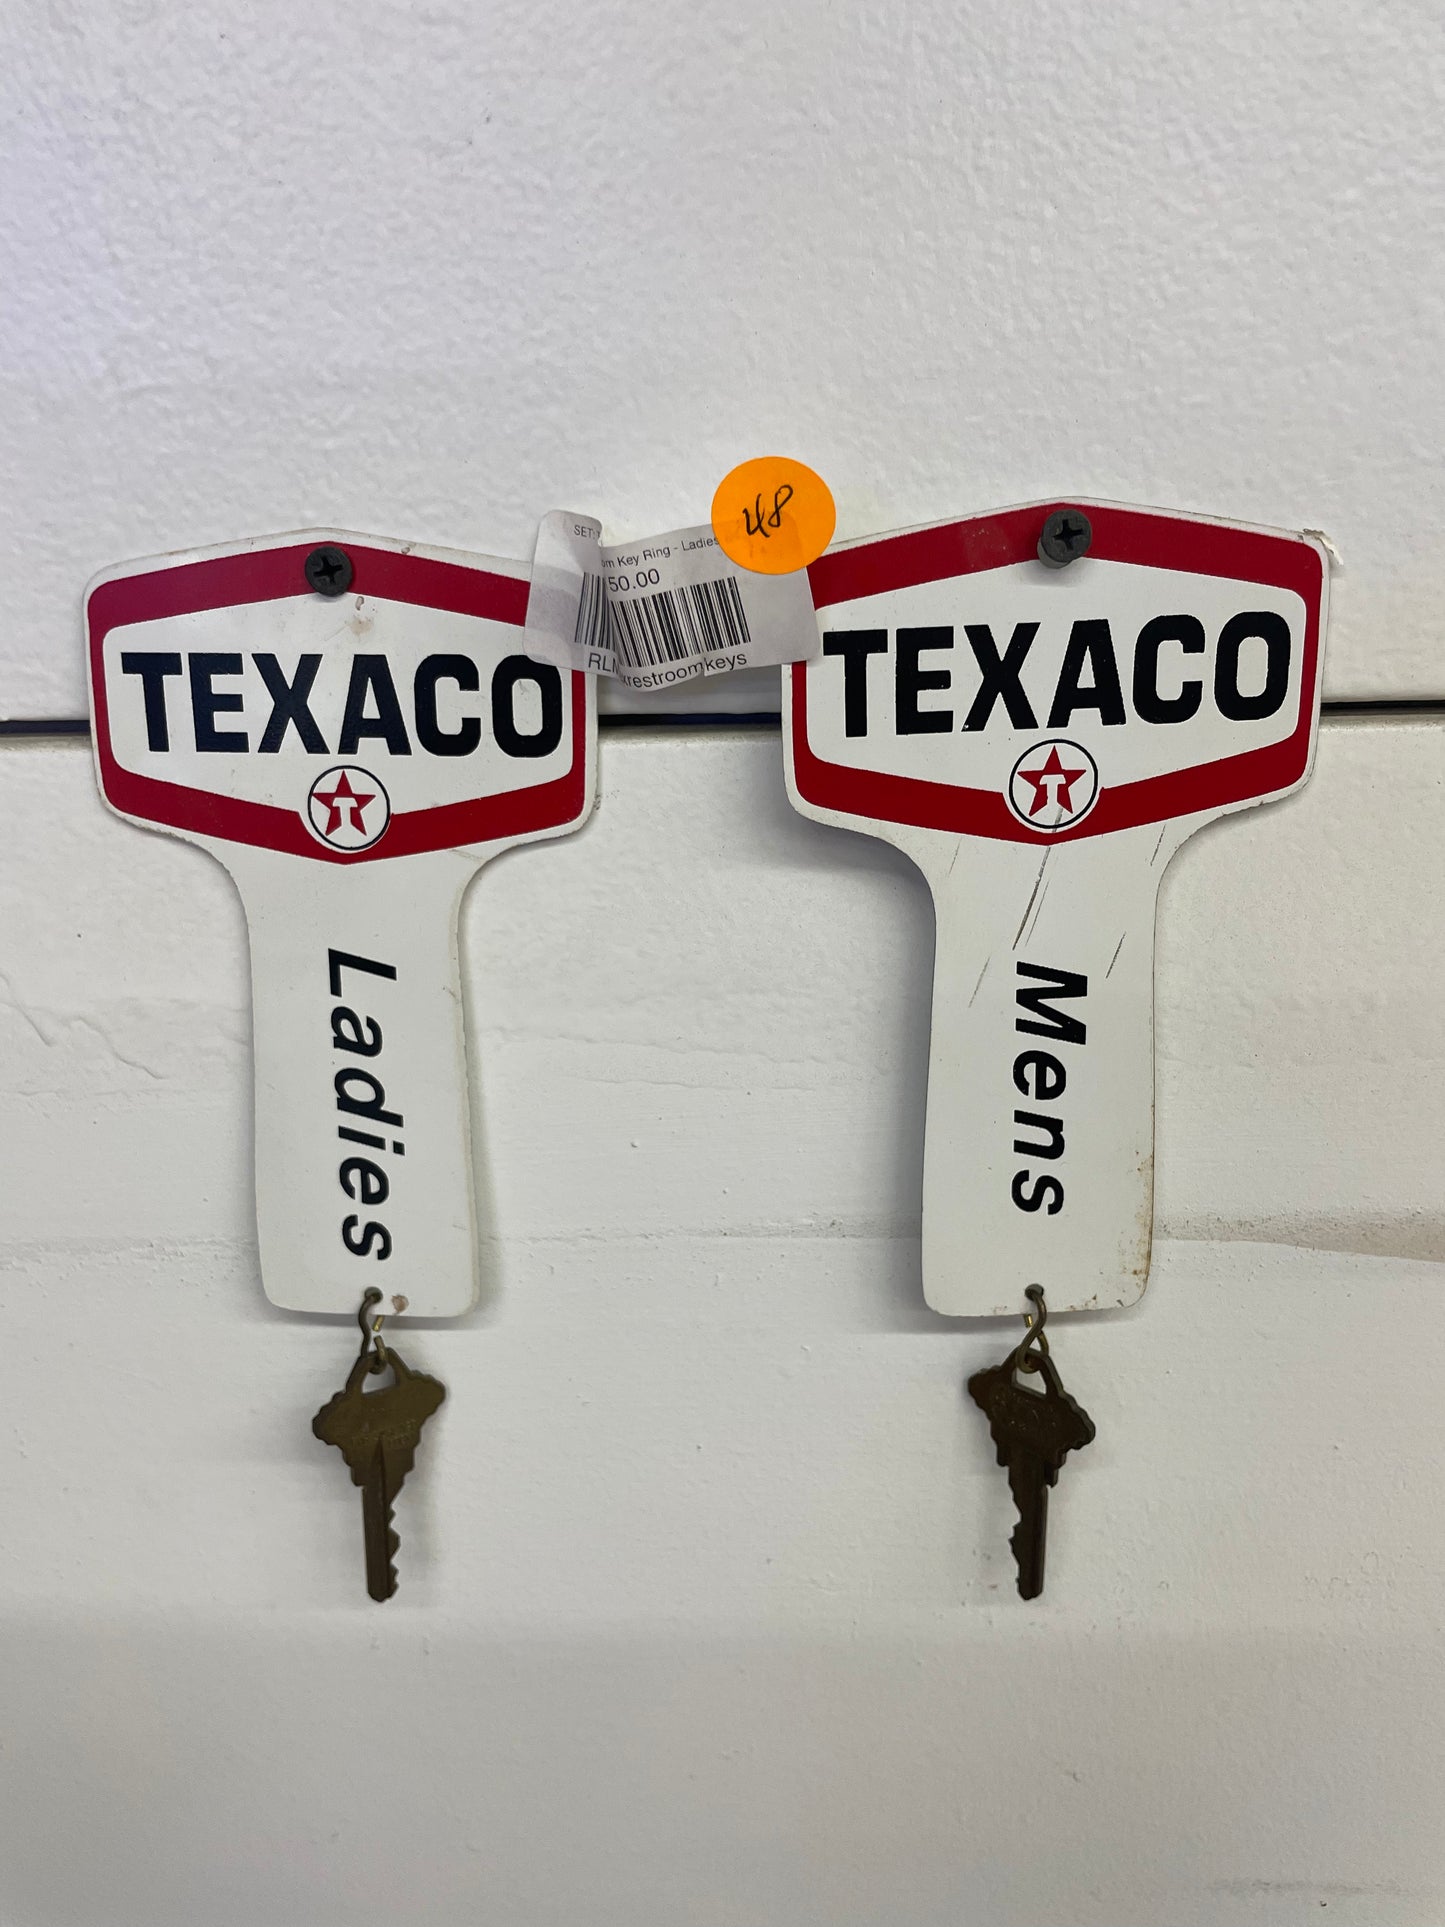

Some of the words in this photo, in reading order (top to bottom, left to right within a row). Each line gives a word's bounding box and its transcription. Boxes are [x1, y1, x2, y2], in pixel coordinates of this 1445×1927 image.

[617, 555, 639, 568] Key
[643, 546, 670, 561] Ring
[681, 536, 720, 551] Ladies
[742, 485, 793, 538] 48
[121, 652, 563, 758] TEXACO
[823, 611, 1291, 738] TEXACO
[328, 948, 405, 1260] Ladies
[1012, 961, 1087, 1215] Mens
